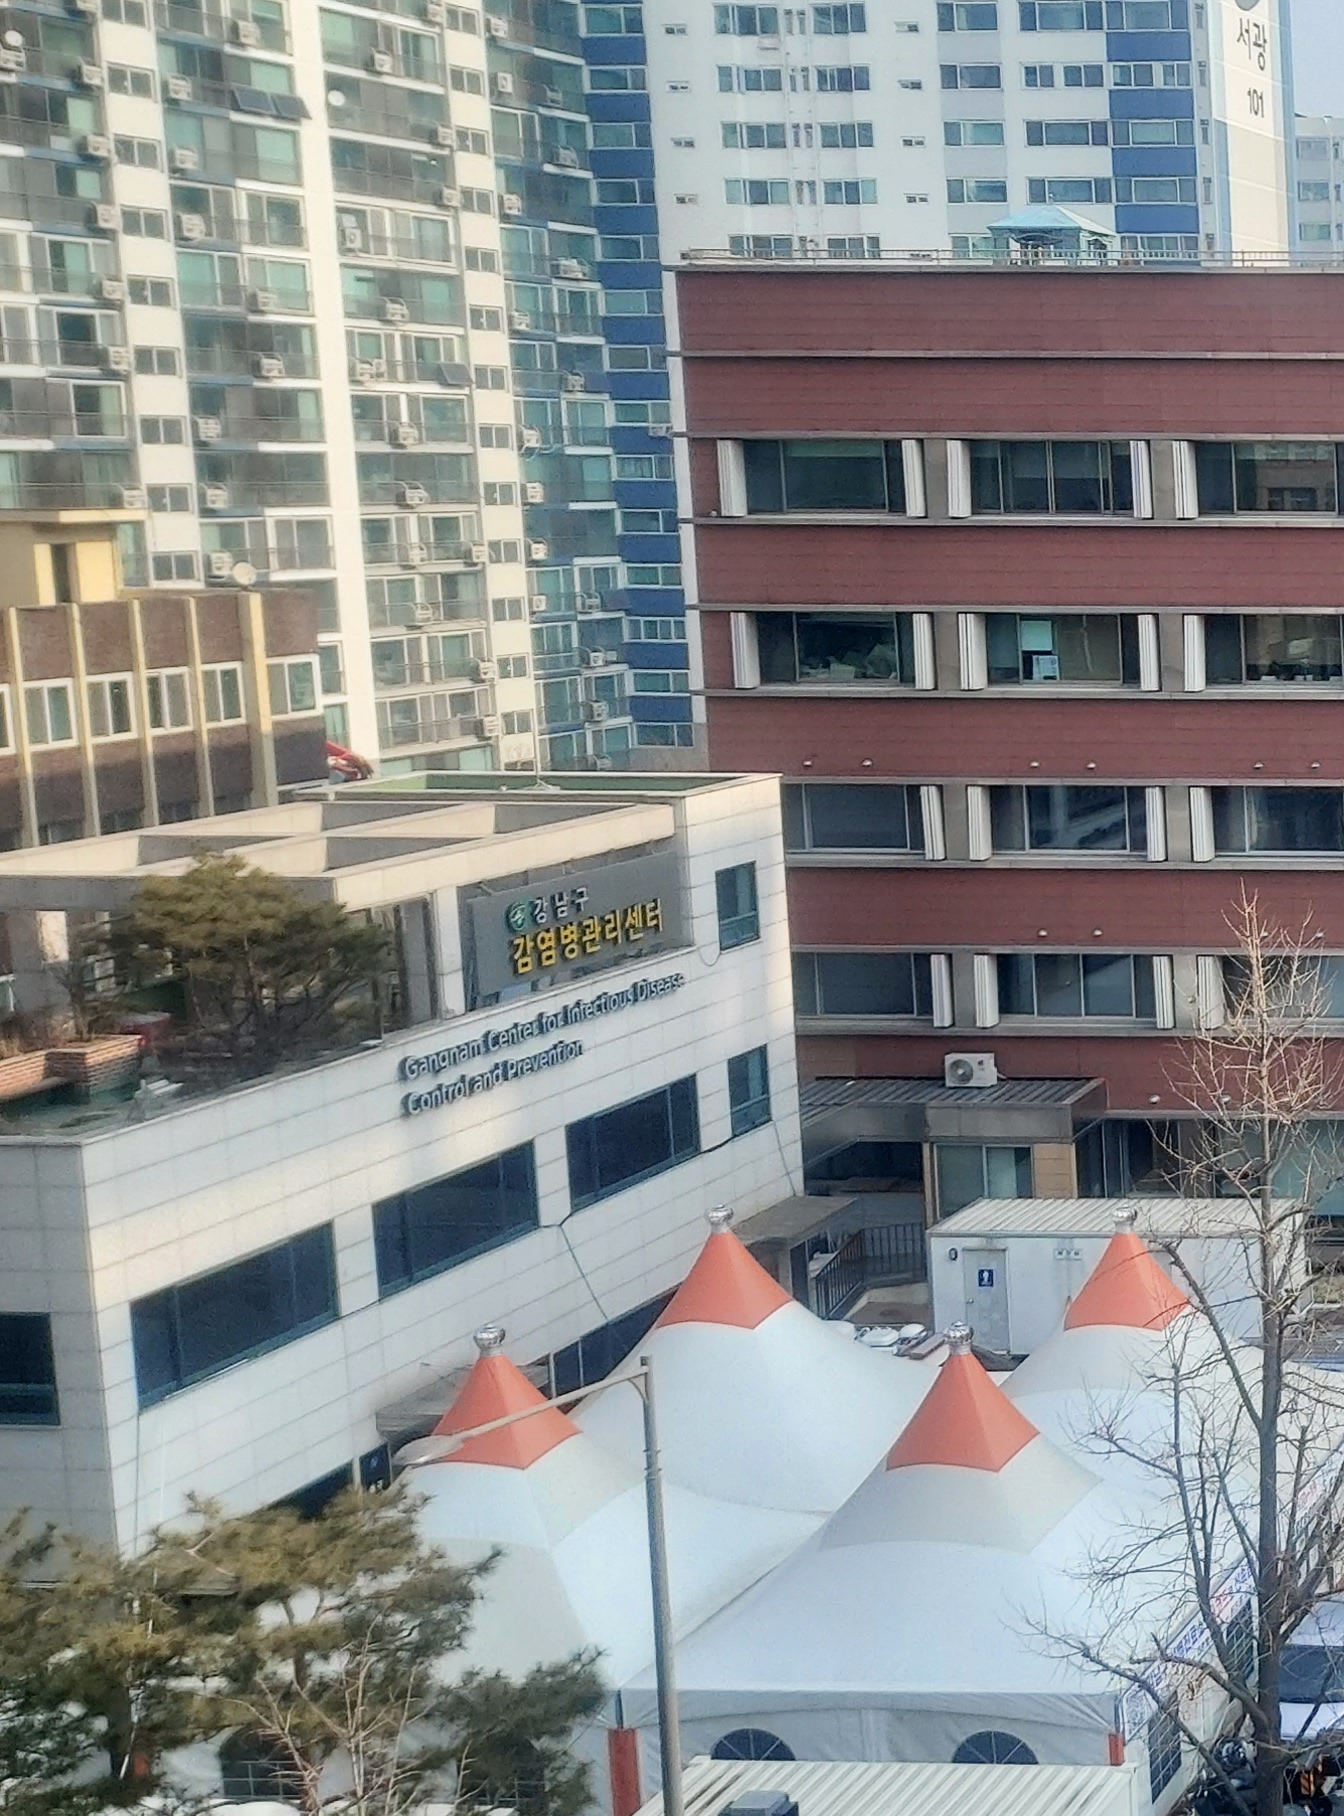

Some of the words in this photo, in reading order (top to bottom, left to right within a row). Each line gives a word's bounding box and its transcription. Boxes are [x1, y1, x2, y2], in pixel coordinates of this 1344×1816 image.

[1236, 17, 1268, 71] 서광
[1247, 87, 1265, 118] 101
[512, 898, 664, 974] 감염병관리센터
[533, 887, 589, 924] 강남구
[402, 1038, 484, 1080] Gangnam
[488, 1023, 539, 1051] Center
[541, 1011, 565, 1032] for
[567, 989, 634, 1025] Infectious
[637, 973, 686, 1003] Disease
[406, 1073, 473, 1116] Control
[474, 1062, 503, 1092] and
[507, 1038, 584, 1079] Prevention
